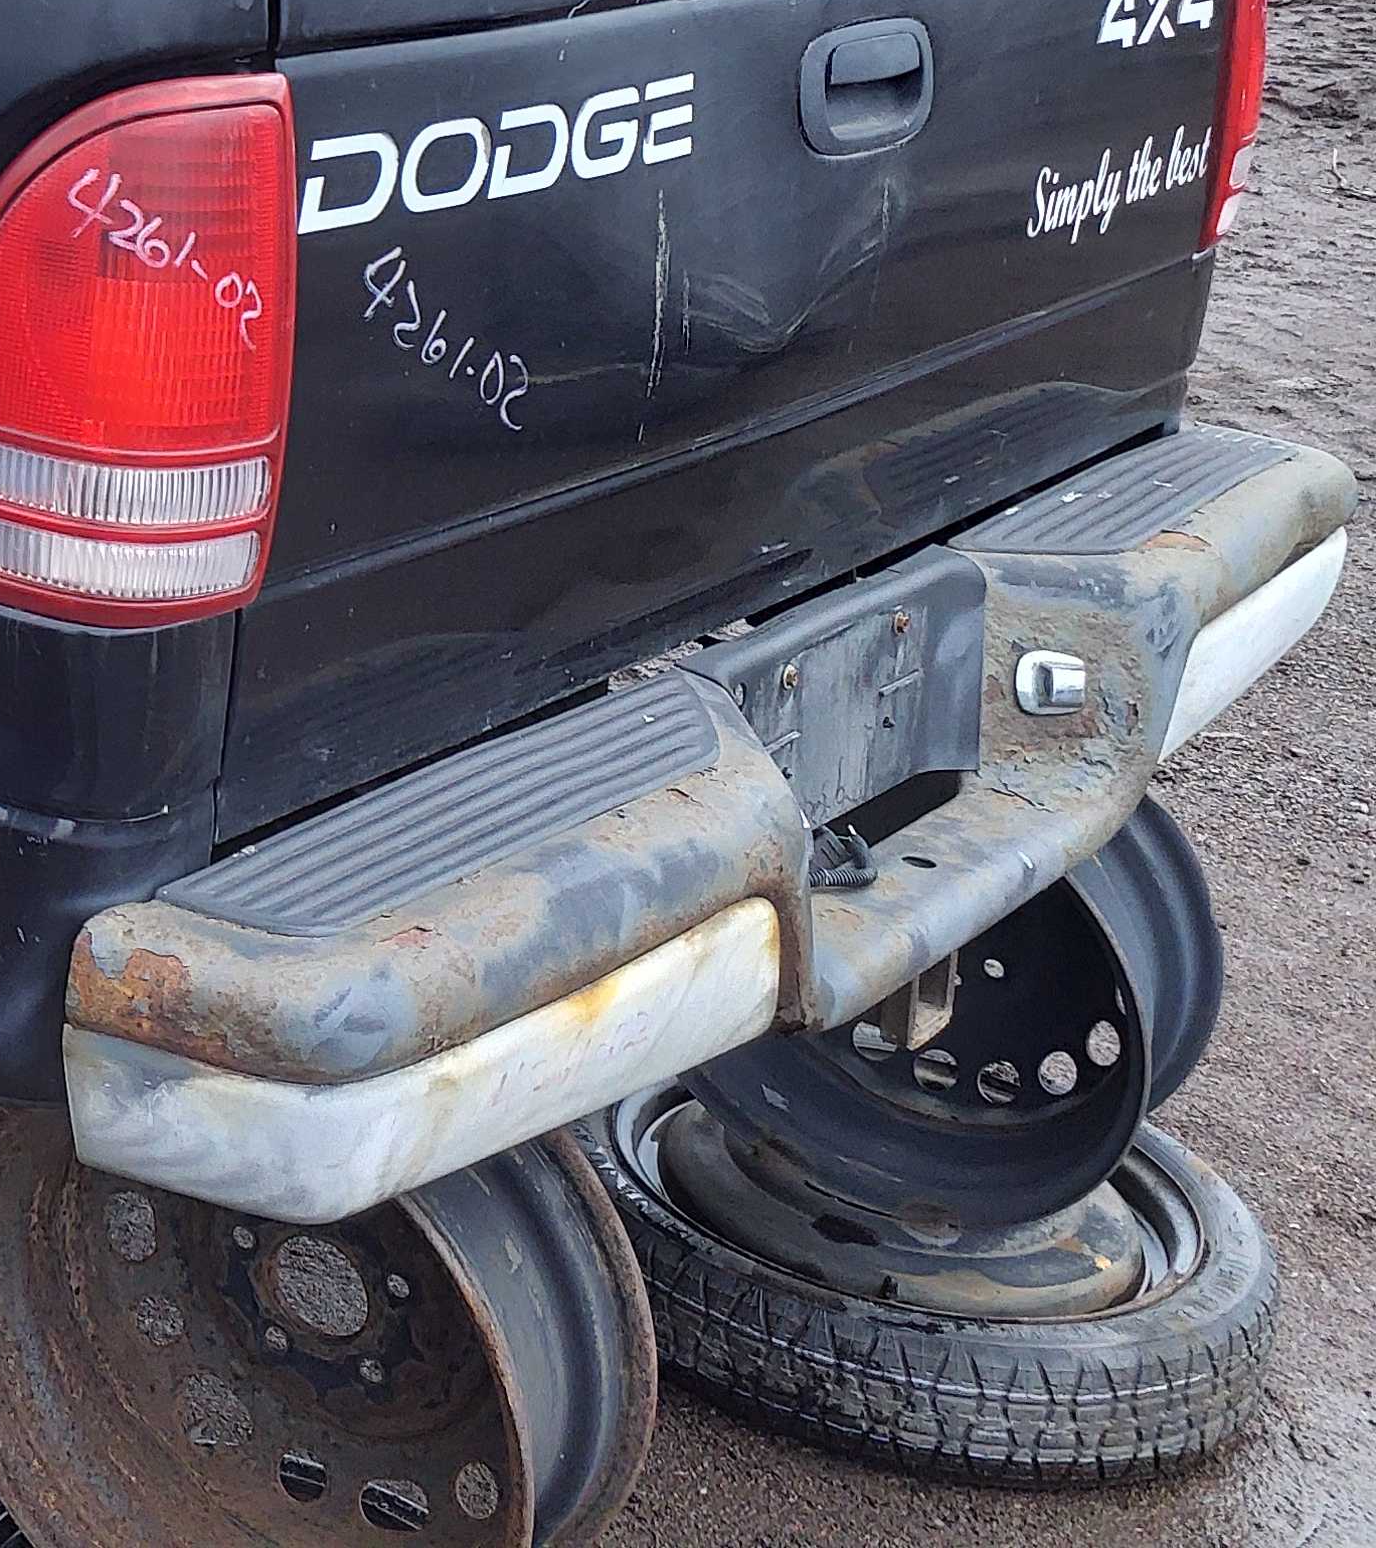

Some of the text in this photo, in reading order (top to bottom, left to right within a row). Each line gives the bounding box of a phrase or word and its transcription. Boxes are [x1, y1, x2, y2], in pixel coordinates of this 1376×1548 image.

[297, 72, 696, 235] DODGE
[1026, 124, 1213, 245] Simply the best
